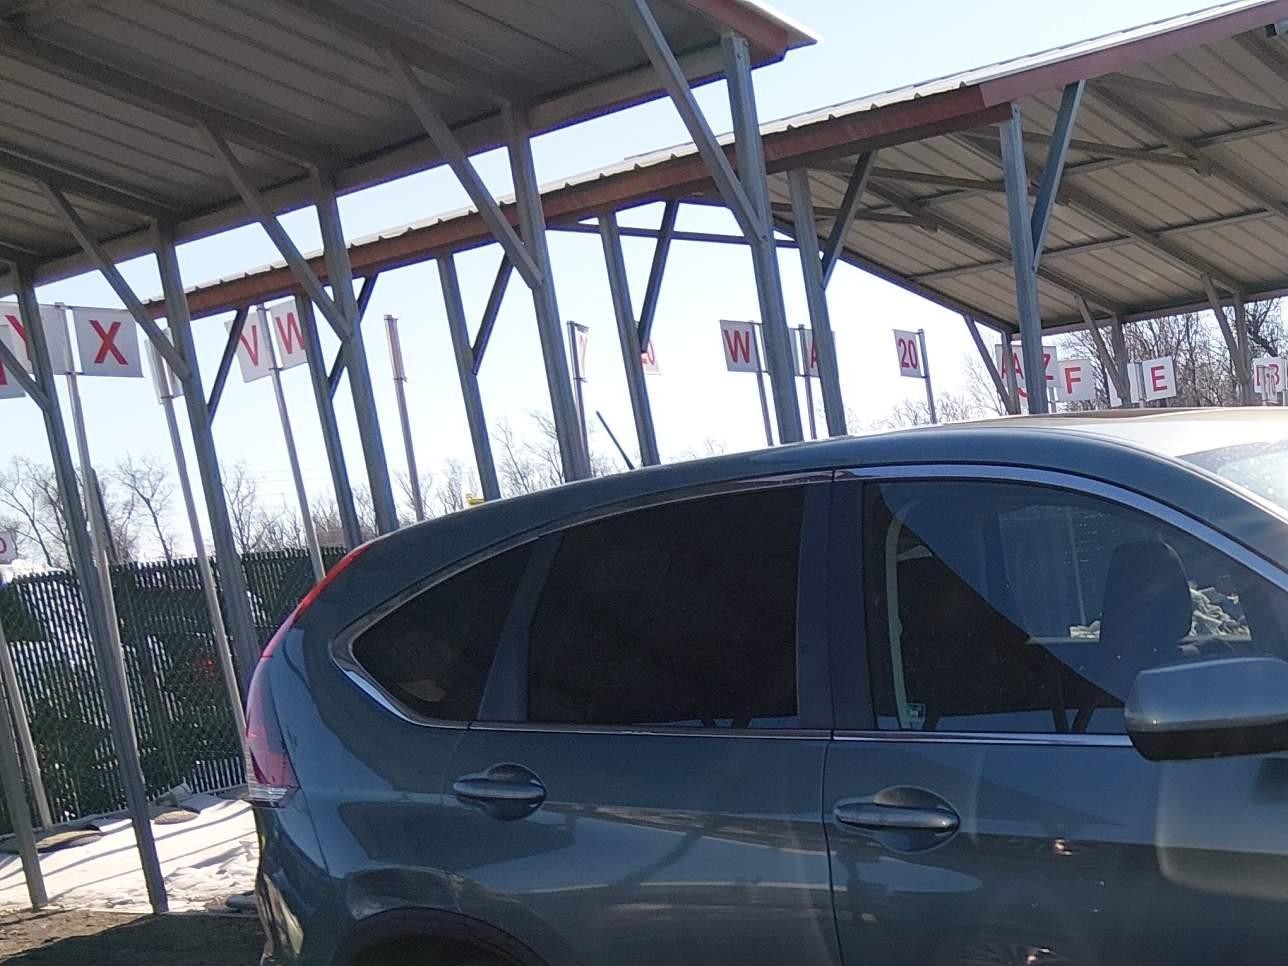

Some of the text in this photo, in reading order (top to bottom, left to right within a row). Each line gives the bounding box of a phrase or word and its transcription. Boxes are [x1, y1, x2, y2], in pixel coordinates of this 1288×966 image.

[88, 319, 128, 365] X
[723, 329, 750, 363] W
[898, 338, 917, 369] 20
[1064, 366, 1082, 394] F
[1150, 365, 1168, 392] E
